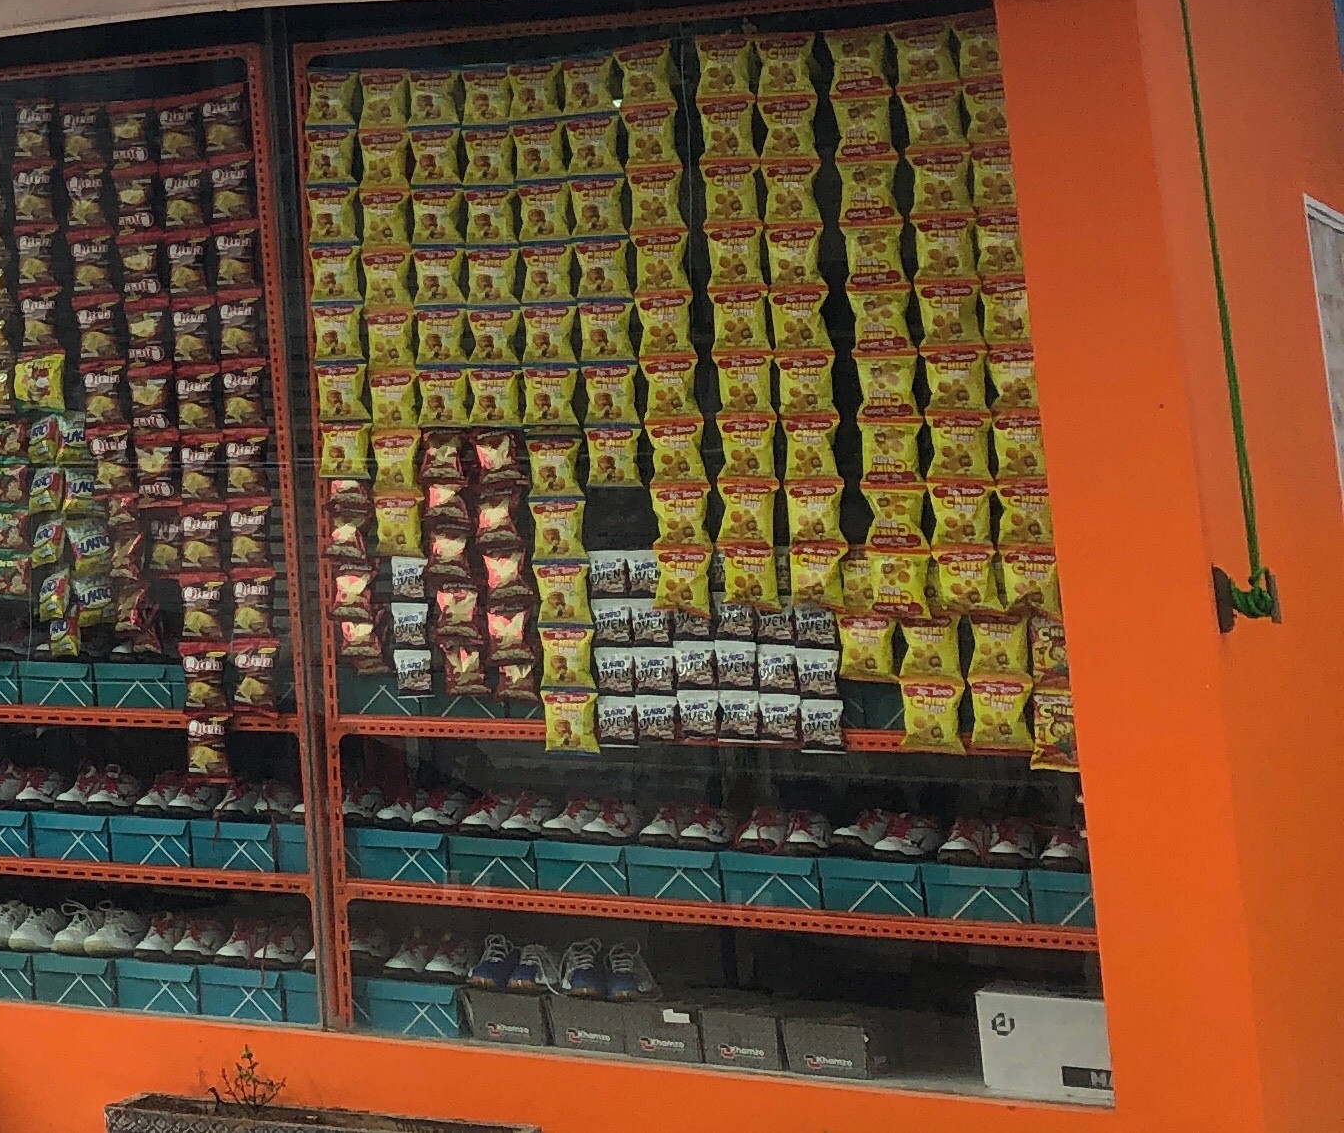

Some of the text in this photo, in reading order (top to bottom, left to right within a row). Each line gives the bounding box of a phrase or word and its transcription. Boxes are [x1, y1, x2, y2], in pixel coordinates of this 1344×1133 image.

[76, 536, 110, 555] SUKRO
[77, 586, 111, 606] SUKRO
[601, 715, 632, 730] OVEN
[639, 715, 672, 729] OVEN
[681, 710, 713, 724] OVEN
[723, 711, 753, 724] OVEN
[763, 714, 794, 724] OVEN
[804, 720, 837, 733] OVEN
